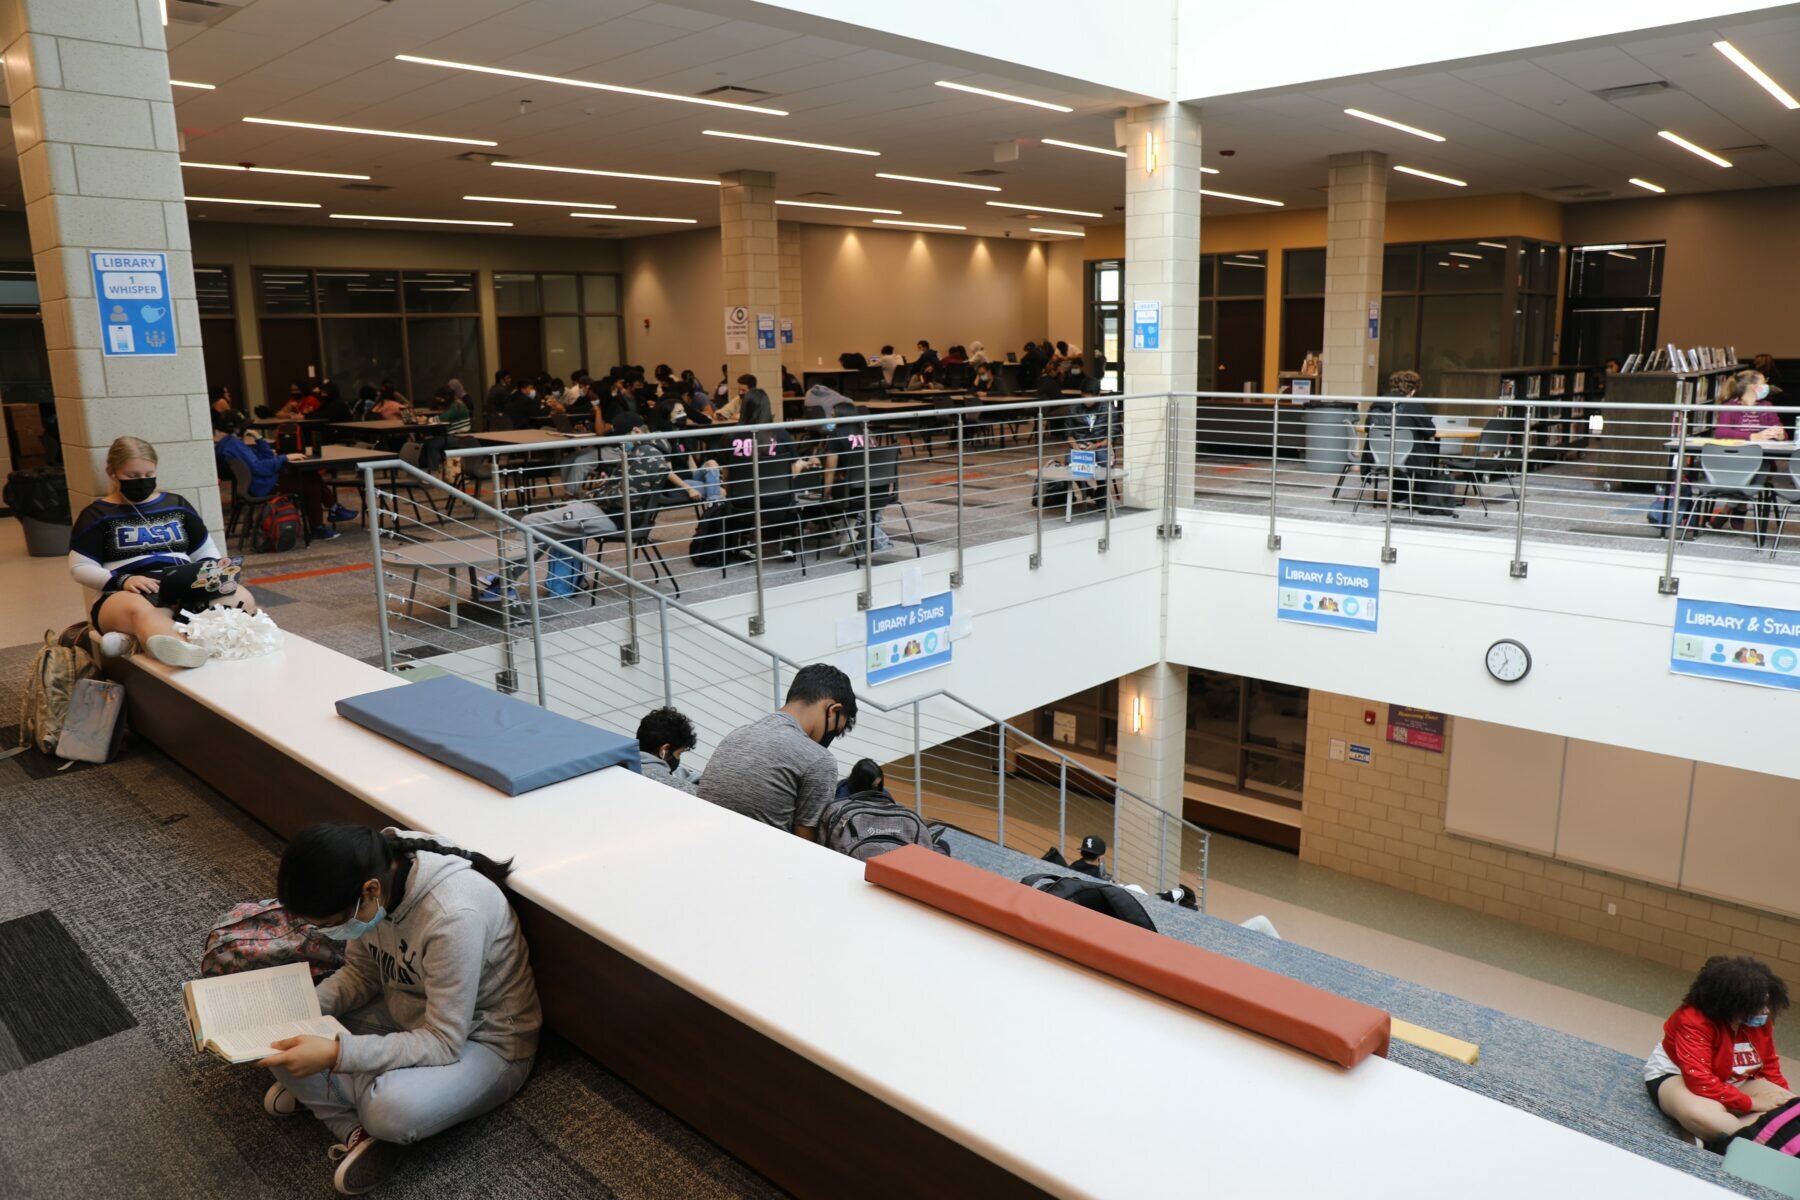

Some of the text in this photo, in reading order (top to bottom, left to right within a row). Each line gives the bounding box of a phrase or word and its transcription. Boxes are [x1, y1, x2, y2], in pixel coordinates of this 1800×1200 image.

[102, 257, 156, 268] LIBRARY
[128, 275, 135, 285] 1
[108, 285, 158, 294] WHISPER
[116, 520, 184, 550] EAST
[1285, 566, 1369, 589] LIBRARY & STAIRS
[872, 606, 944, 634] LIBRARY & STAIRS
[1685, 608, 1745, 630] LIBRARY
[1747, 616, 1760, 632] &
[1685, 642, 1691, 651] 1
